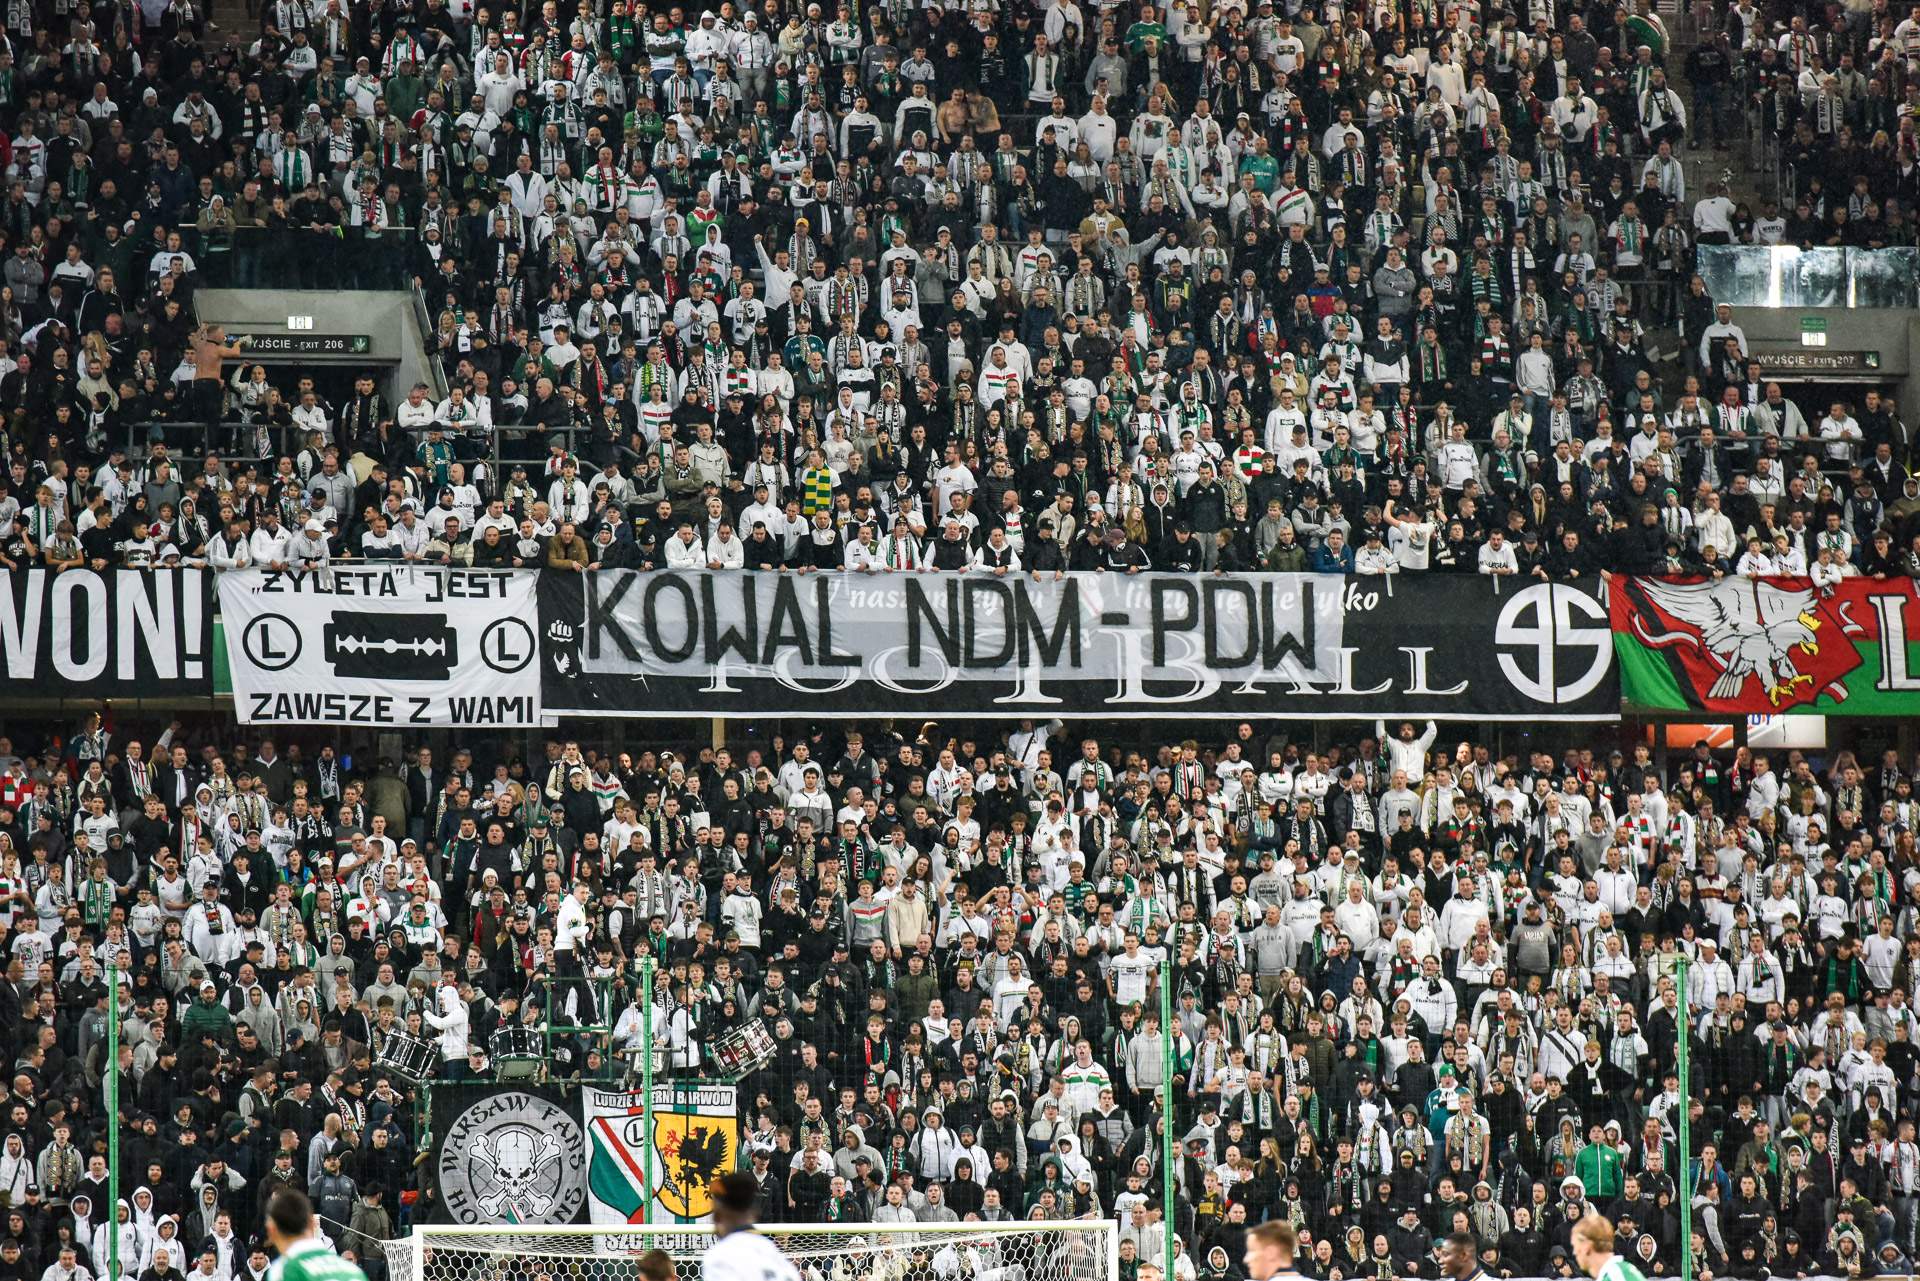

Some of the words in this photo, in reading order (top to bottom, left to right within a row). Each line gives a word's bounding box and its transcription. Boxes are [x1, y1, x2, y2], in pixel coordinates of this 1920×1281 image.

[251, 337, 291, 349] YJŚCIE
[324, 340, 343, 349] 206
[1758, 354, 1805, 365] WYJŚCIE
[424, 571, 514, 602] JEST
[586, 571, 862, 668] KOWAL
[250, 693, 393, 723] ZAWSZE
[408, 697, 431, 723] Z
[449, 696, 534, 724] WAMI
[594, 1092, 633, 1108] LUDZIE
[633, 1089, 675, 1107] WERNI
[676, 1090, 733, 1107] BARWOM
[442, 1095, 530, 1175] WARSAW
[541, 1106, 586, 1171] FANS
